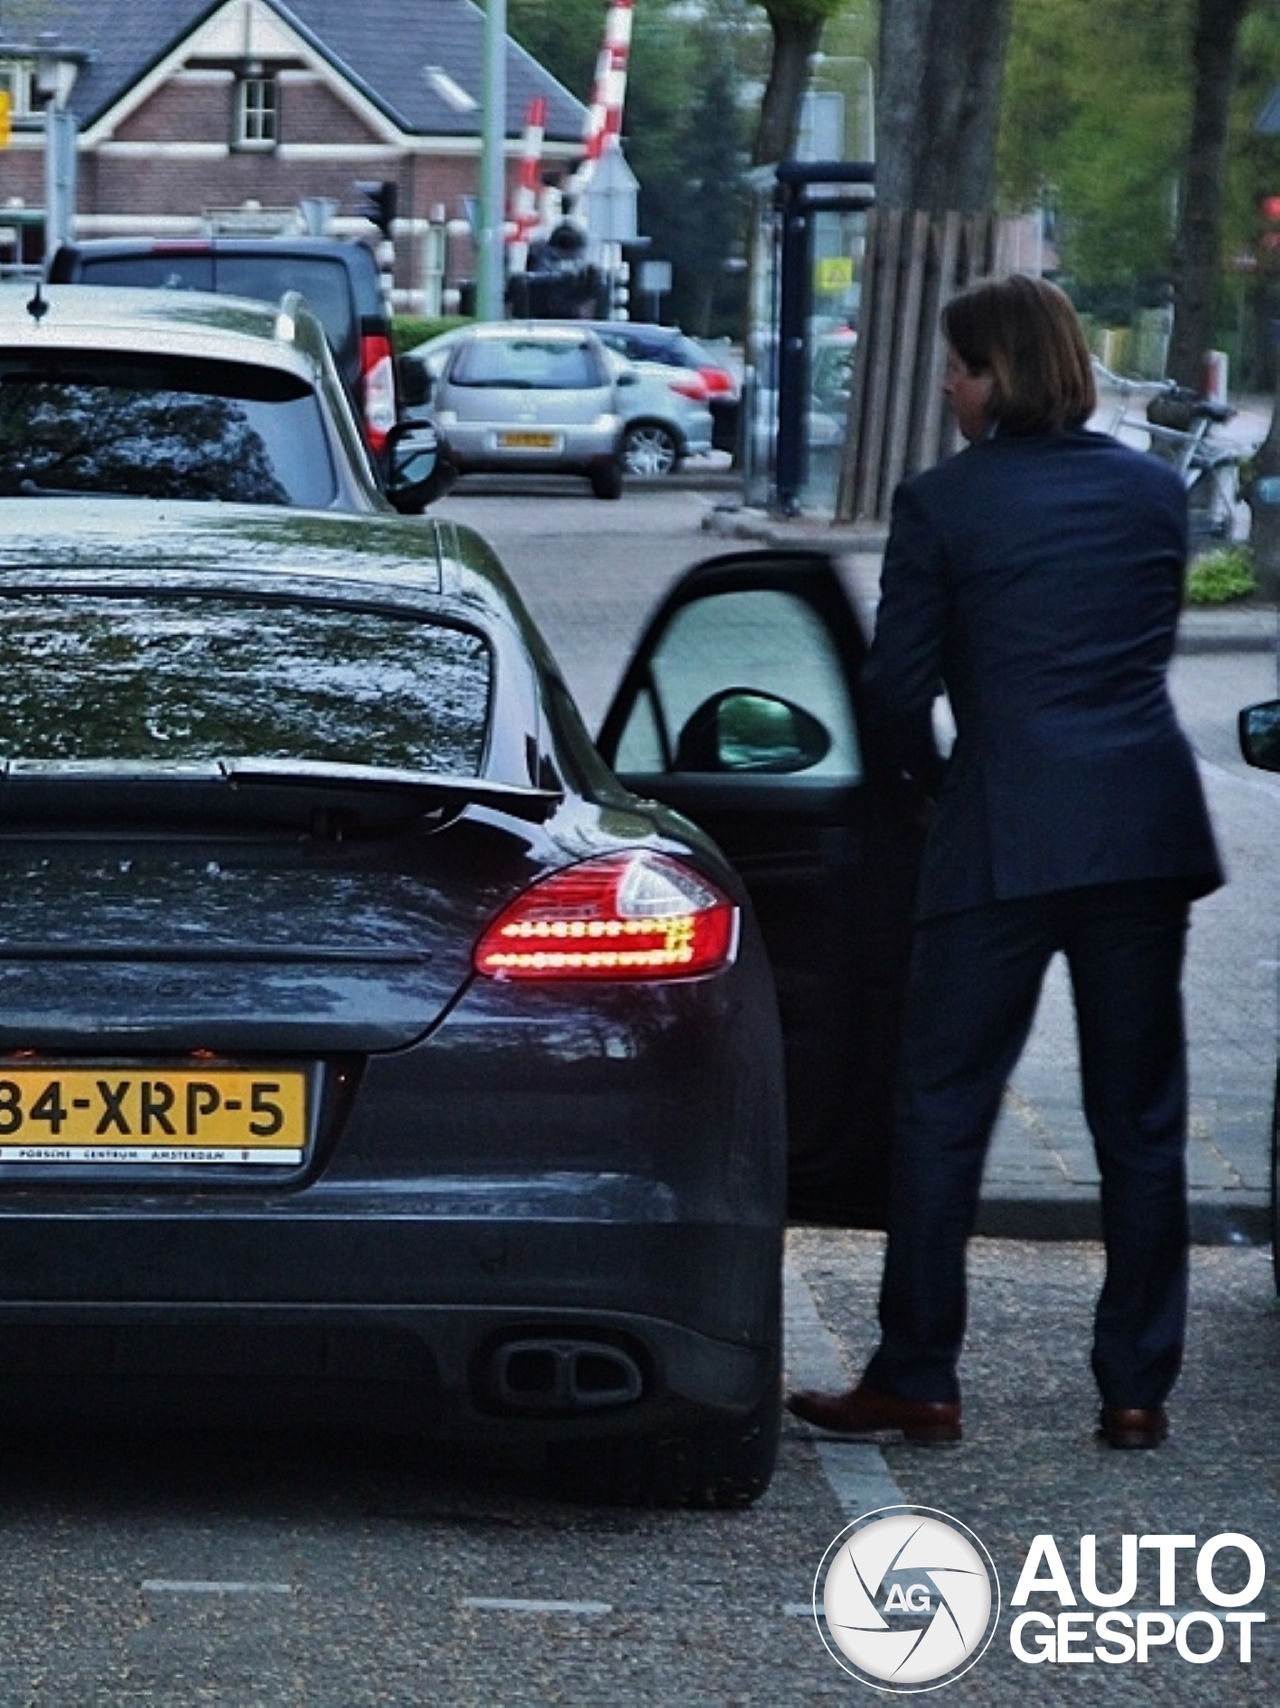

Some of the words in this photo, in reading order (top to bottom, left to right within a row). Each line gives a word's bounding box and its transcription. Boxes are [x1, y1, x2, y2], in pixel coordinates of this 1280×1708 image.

[19, 1149, 70, 1159] PORSCHE
[84, 1149, 138, 1160] CENTRUM
[151, 1150, 225, 1160] AMSTERDAM
